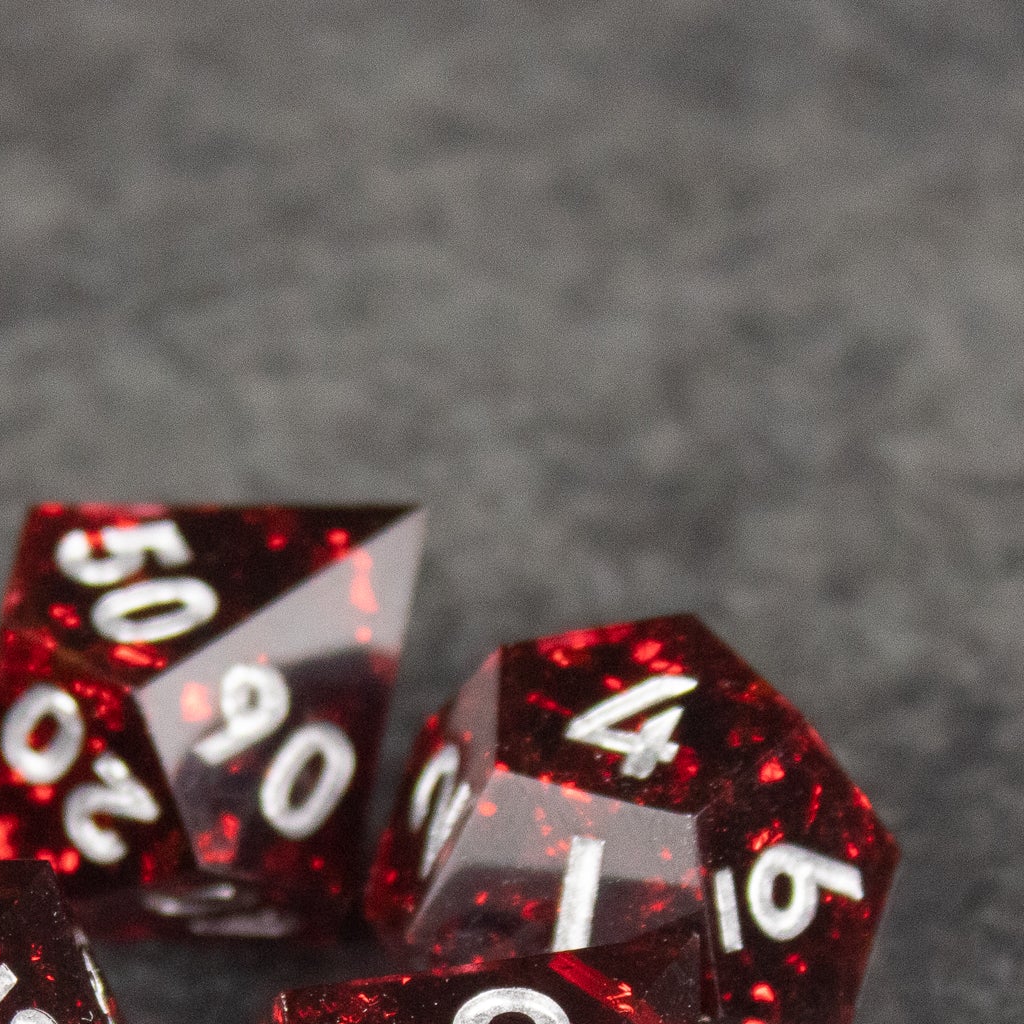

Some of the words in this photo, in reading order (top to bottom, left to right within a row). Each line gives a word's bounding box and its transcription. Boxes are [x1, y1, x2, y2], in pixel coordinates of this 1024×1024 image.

[55, 518, 220, 644] 50
[0, 682, 161, 864] 20
[195, 664, 357, 841] 90
[565, 675, 698, 780] 4
